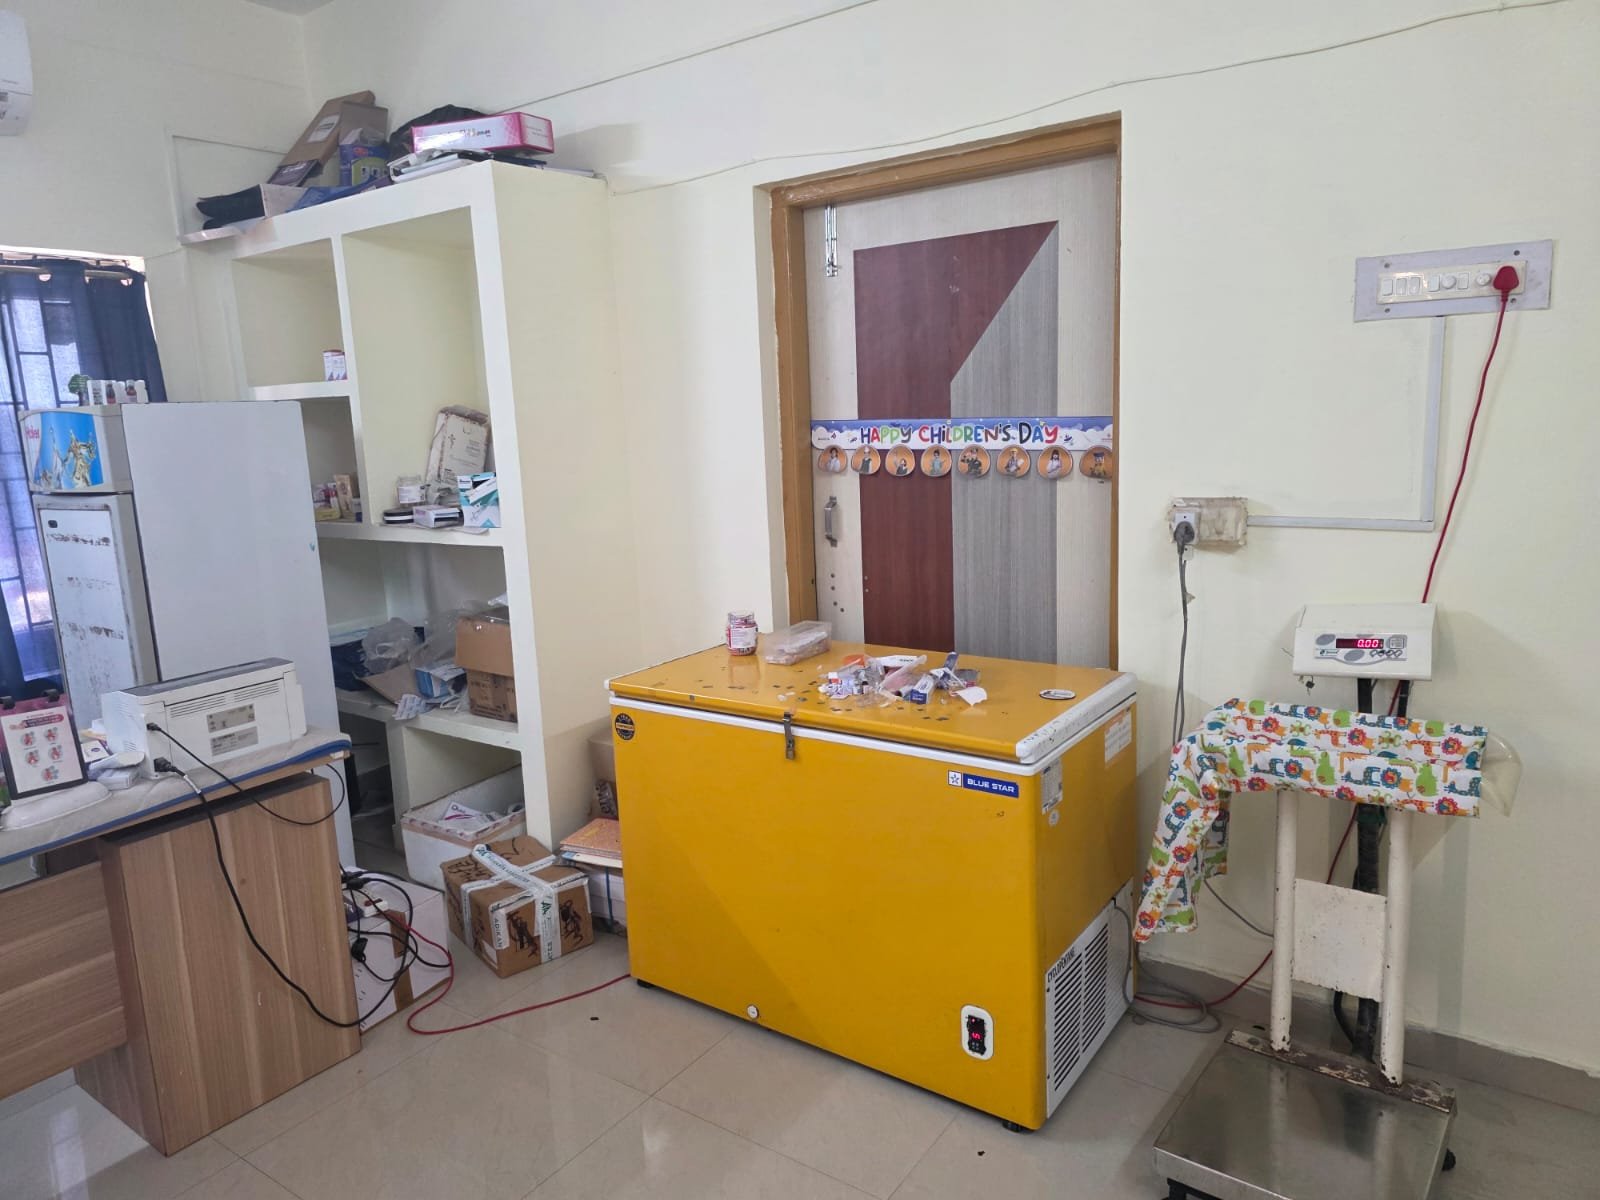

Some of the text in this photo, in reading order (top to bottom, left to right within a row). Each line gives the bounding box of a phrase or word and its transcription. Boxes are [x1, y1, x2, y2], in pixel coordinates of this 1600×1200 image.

[860, 425, 912, 444] HAPPY
[1018, 421, 1059, 444] DAY
[1357, 639, 1379, 648] 0.00
[967, 778, 1015, 793] BLUE STAR
